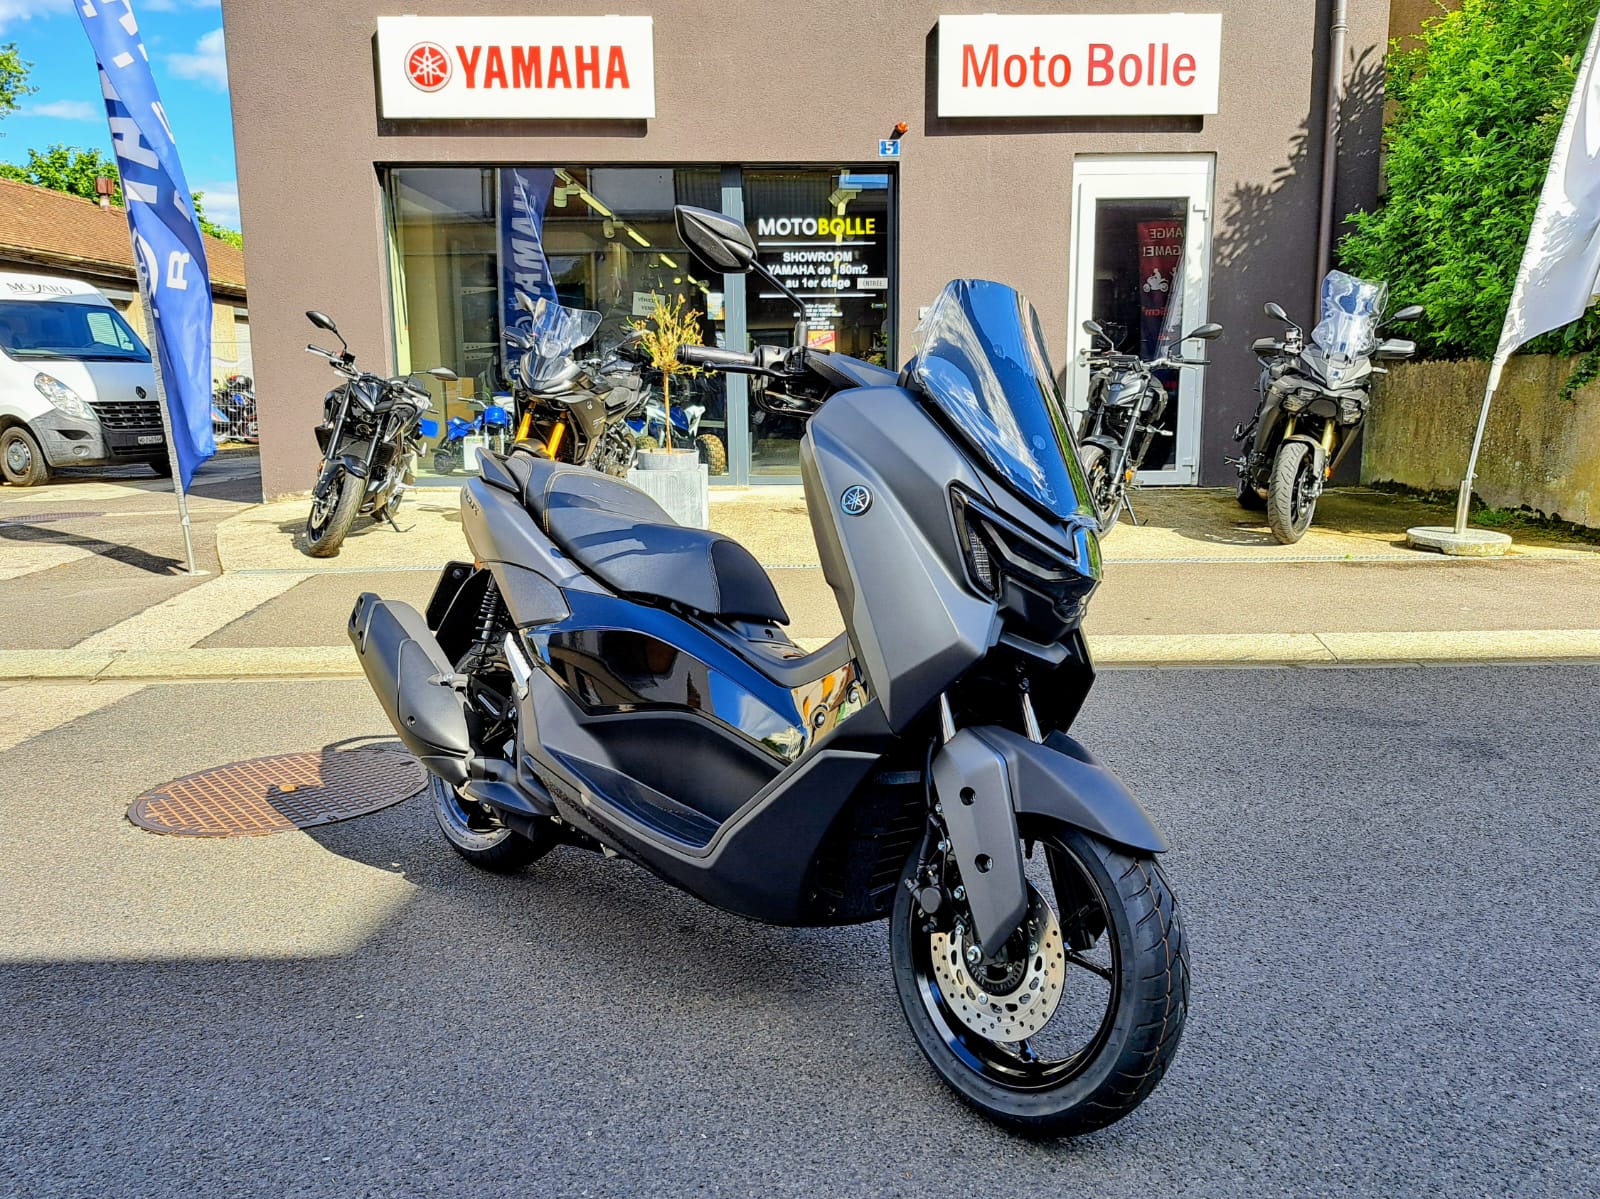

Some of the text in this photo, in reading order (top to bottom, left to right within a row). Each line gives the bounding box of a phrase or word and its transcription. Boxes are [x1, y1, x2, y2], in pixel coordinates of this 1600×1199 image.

[455, 45, 630, 89] YAMAHA
[961, 43, 1197, 88] Moto Bolle
[885, 141, 894, 154] 5
[758, 217, 876, 236] MOTOBOLLE
[782, 251, 853, 263] SHOWROOM
[767, 264, 816, 276] YAMAHA
[817, 264, 831, 275] de
[785, 277, 851, 290] au 1er étage
